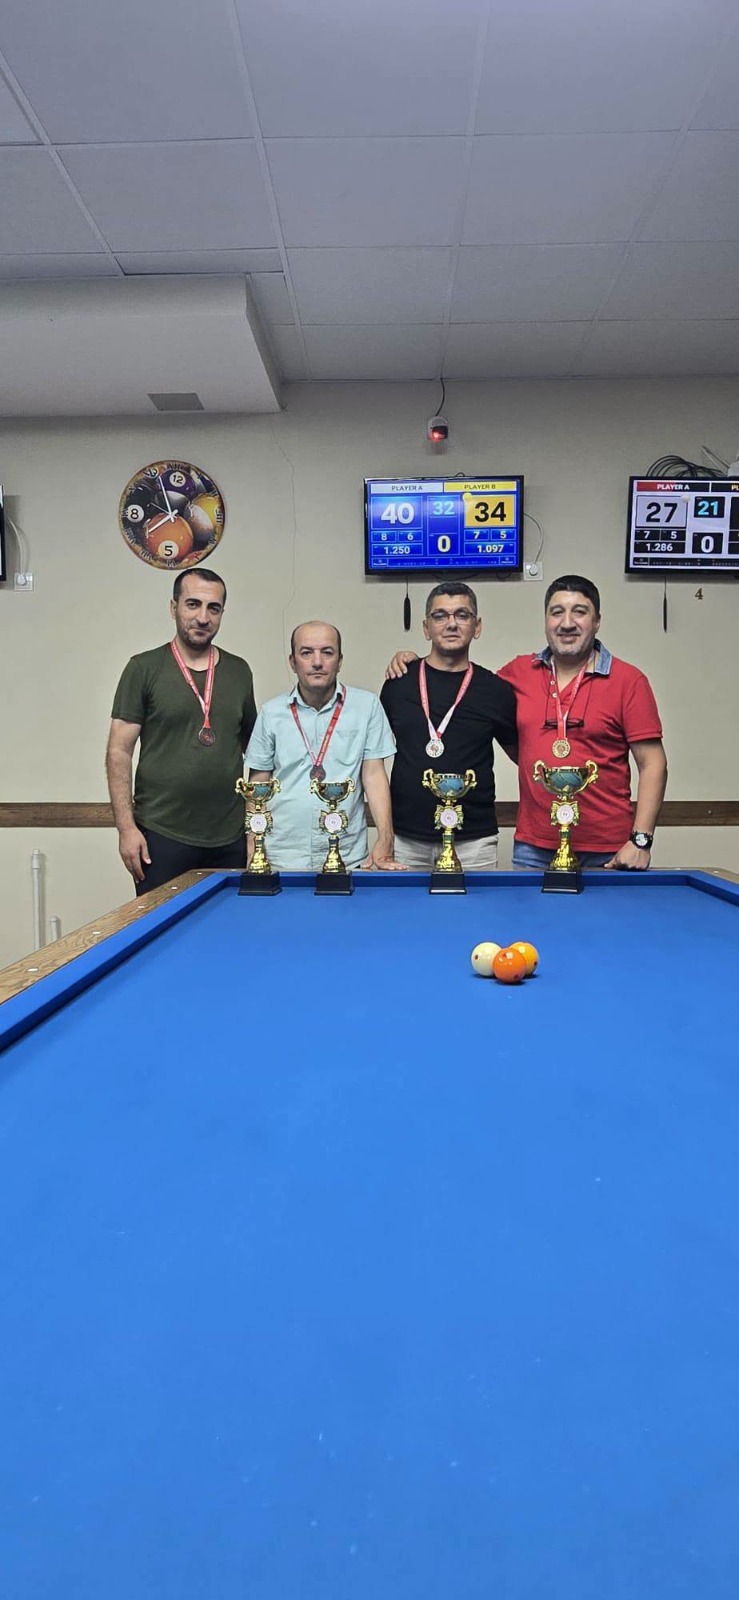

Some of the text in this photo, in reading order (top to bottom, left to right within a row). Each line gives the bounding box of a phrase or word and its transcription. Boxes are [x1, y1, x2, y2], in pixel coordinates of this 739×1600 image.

[172, 474, 184, 485] 12
[380, 502, 415, 524] 40
[433, 501, 455, 515] 32
[474, 501, 507, 522] 34
[645, 502, 678, 523] 27
[697, 501, 719, 515] 21
[130, 508, 139, 520] 8
[381, 533, 388, 541] 8
[407, 532, 414, 541] 6
[473, 531, 480, 539] 7
[500, 531, 507, 539] 5
[643, 531, 650, 539] 7
[670, 531, 677, 539] 5
[437, 534, 451, 553] 0
[477, 544, 504, 553] 1.097
[645, 543, 673, 552] 1.286
[700, 535, 714, 553] 0
[164, 545, 173, 556] 5
[384, 546, 410, 555] 1.250
[694, 587, 704, 600] 4
